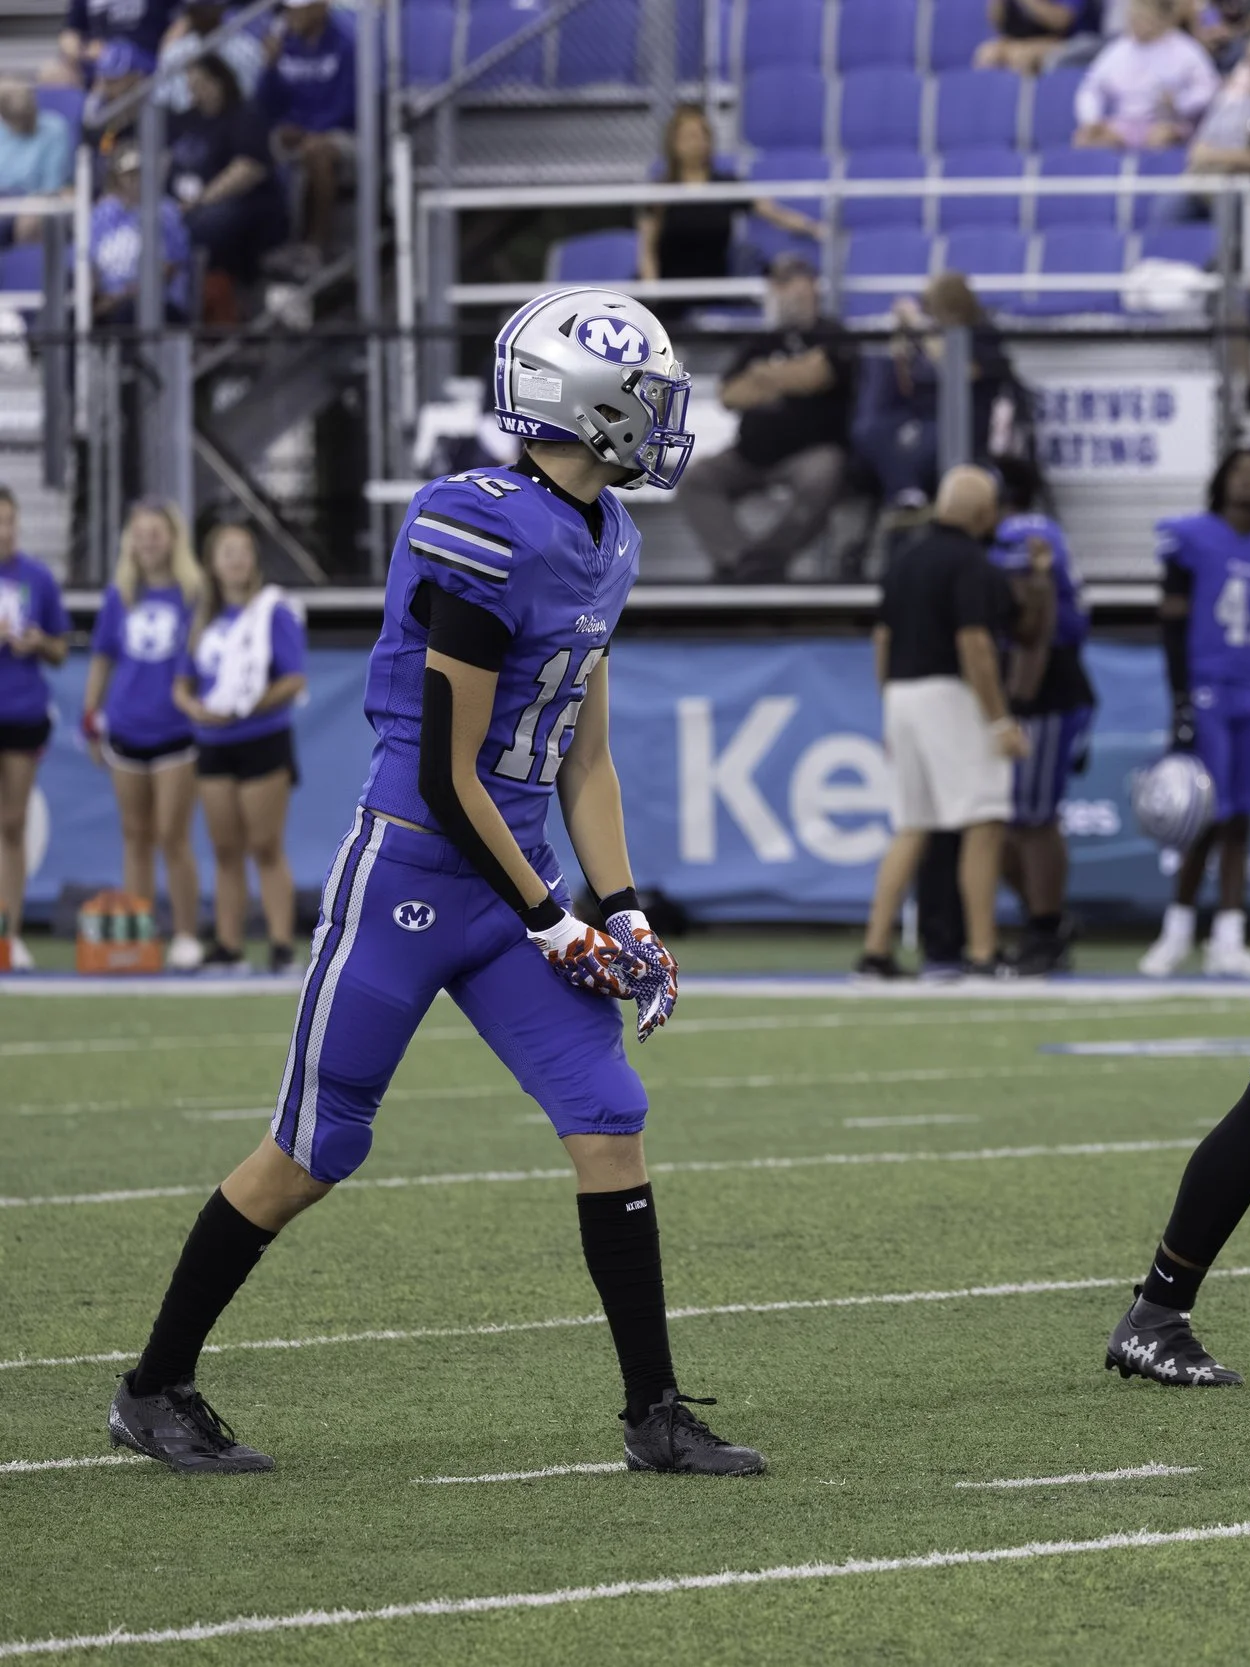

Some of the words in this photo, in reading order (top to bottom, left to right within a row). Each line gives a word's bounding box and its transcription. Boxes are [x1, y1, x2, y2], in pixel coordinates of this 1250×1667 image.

[585, 319, 644, 362] M
[1034, 388, 1176, 423] SERVED
[1042, 434, 1157, 466] ATING
[490, 647, 605, 785] 12
[676, 697, 893, 864] Ke
[399, 904, 430, 927] M
